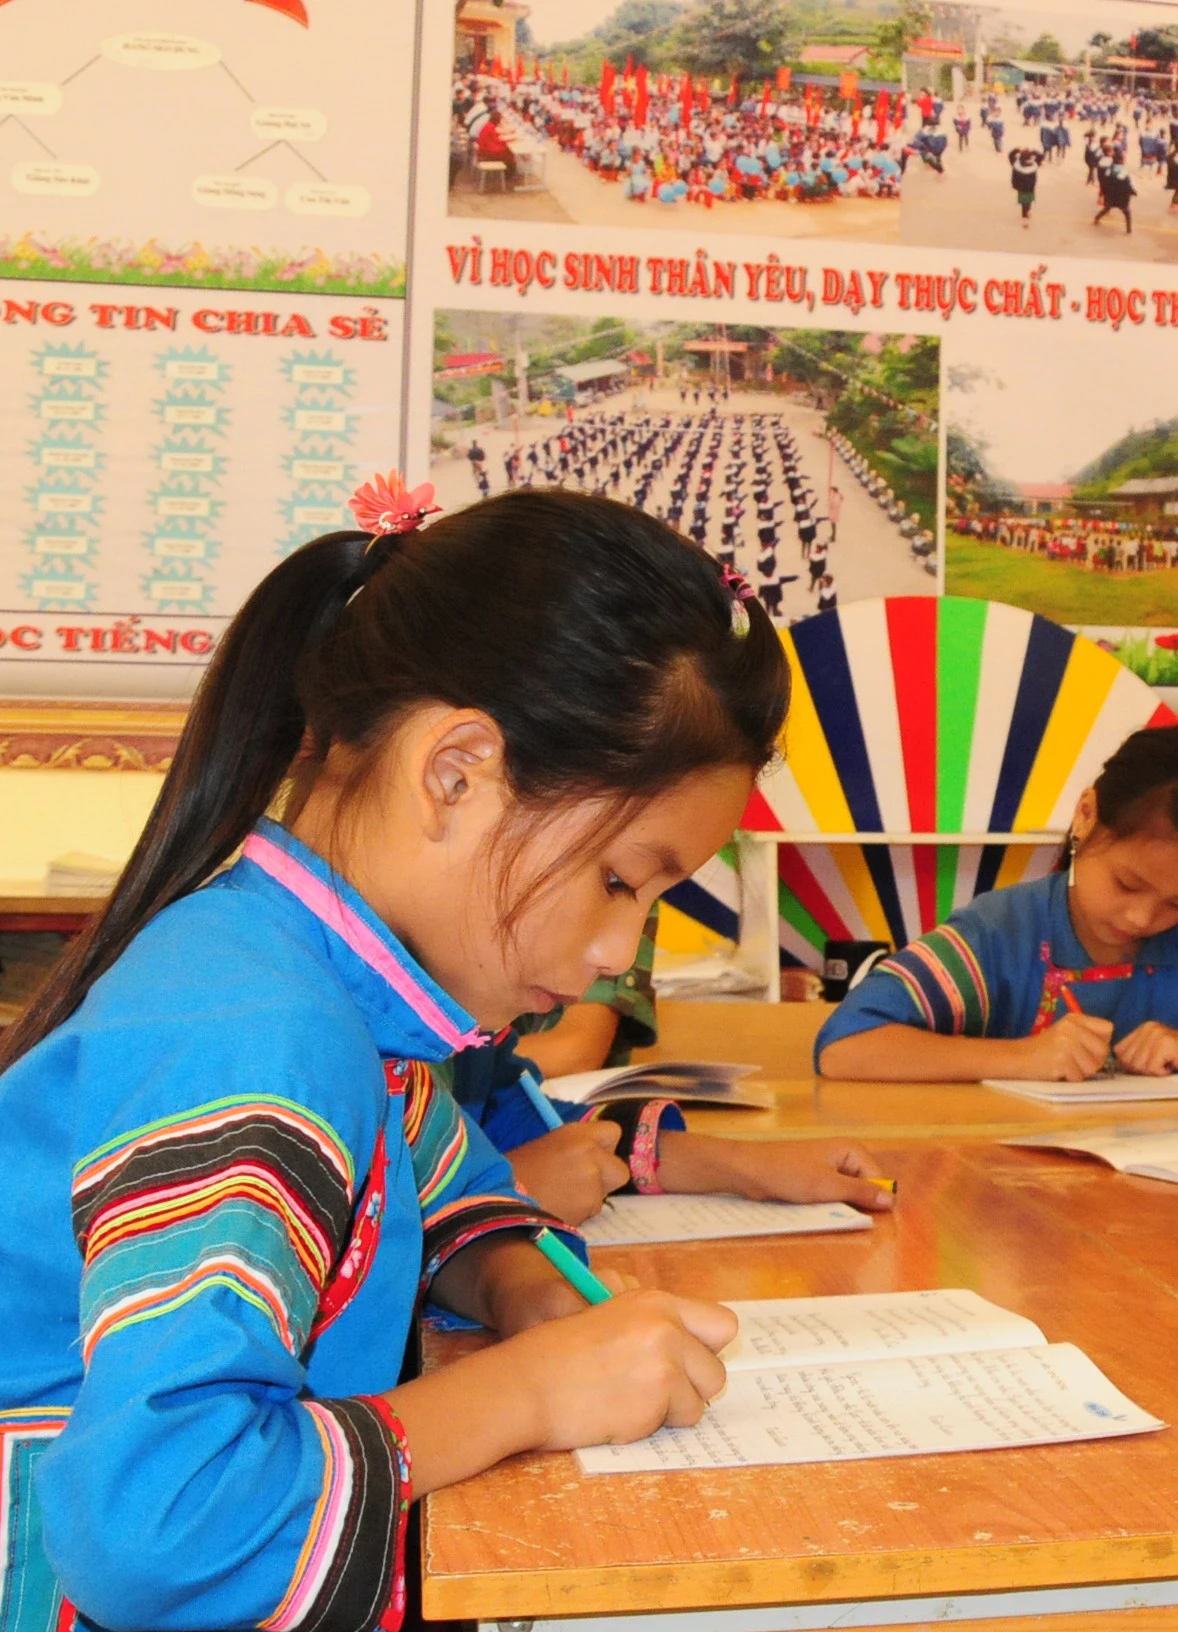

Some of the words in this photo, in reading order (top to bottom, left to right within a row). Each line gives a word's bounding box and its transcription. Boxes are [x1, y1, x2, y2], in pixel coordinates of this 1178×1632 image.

[446, 235, 482, 286] VÌ
[490, 247, 556, 296] HỌC
[563, 252, 639, 293] SINH
[646, 248, 736, 299] THÂN
[742, 252, 815, 312] YÊU,
[822, 267, 889, 315] DẠY
[895, 268, 978, 321] THỰC
[983, 264, 1066, 319] CHẤT
[1085, 285, 1146, 332] HỌC
[0, 299, 76, 327] NG
[89, 304, 178, 331] TIN
[191, 308, 316, 338] CHIA
[0, 625, 42, 650] C
[56, 615, 215, 655] TIẾNG
